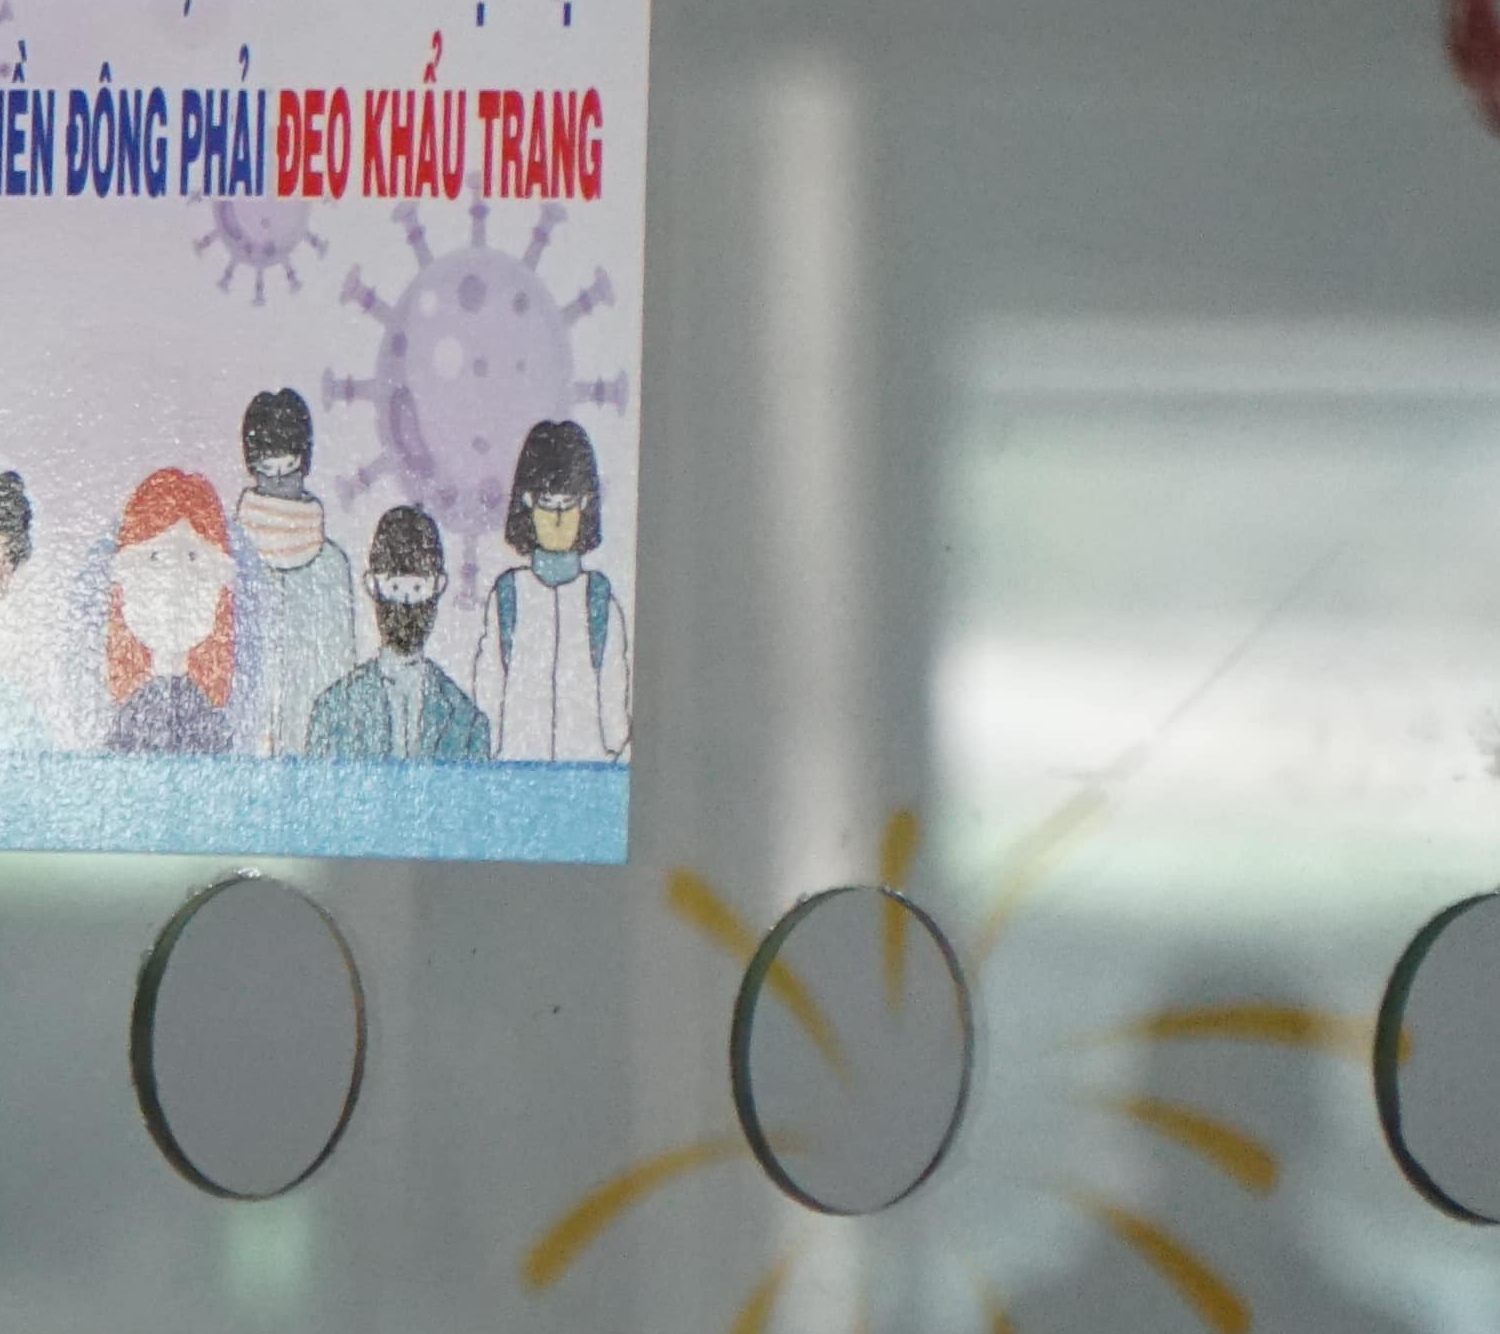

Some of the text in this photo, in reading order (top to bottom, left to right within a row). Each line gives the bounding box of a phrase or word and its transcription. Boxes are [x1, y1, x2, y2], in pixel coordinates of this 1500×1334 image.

[66, 60, 168, 198] ĐÔNG
[178, 43, 266, 197] PHẢI
[276, 87, 348, 199] ĐEO
[362, 29, 465, 199] KHẨU
[477, 86, 603, 200] TRANG
